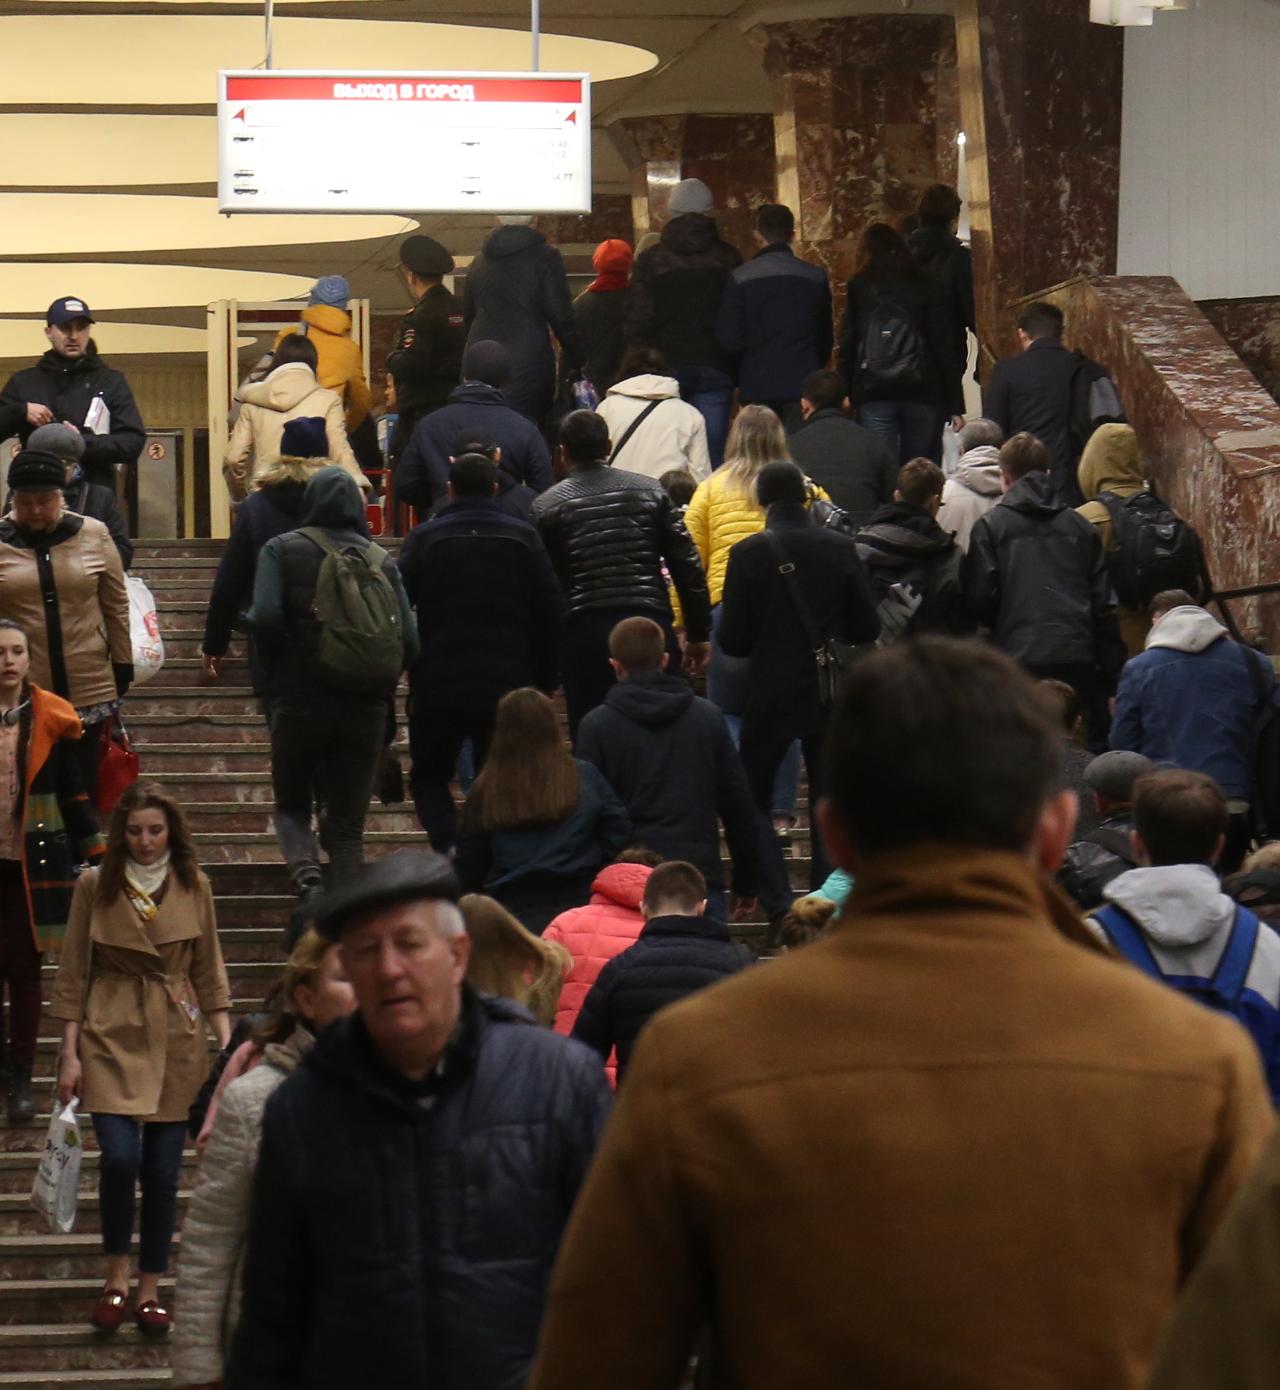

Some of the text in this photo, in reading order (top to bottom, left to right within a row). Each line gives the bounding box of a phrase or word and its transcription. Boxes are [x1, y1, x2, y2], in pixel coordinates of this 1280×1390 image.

[333, 83, 474, 101] ВЫХОД В ГОРОД
